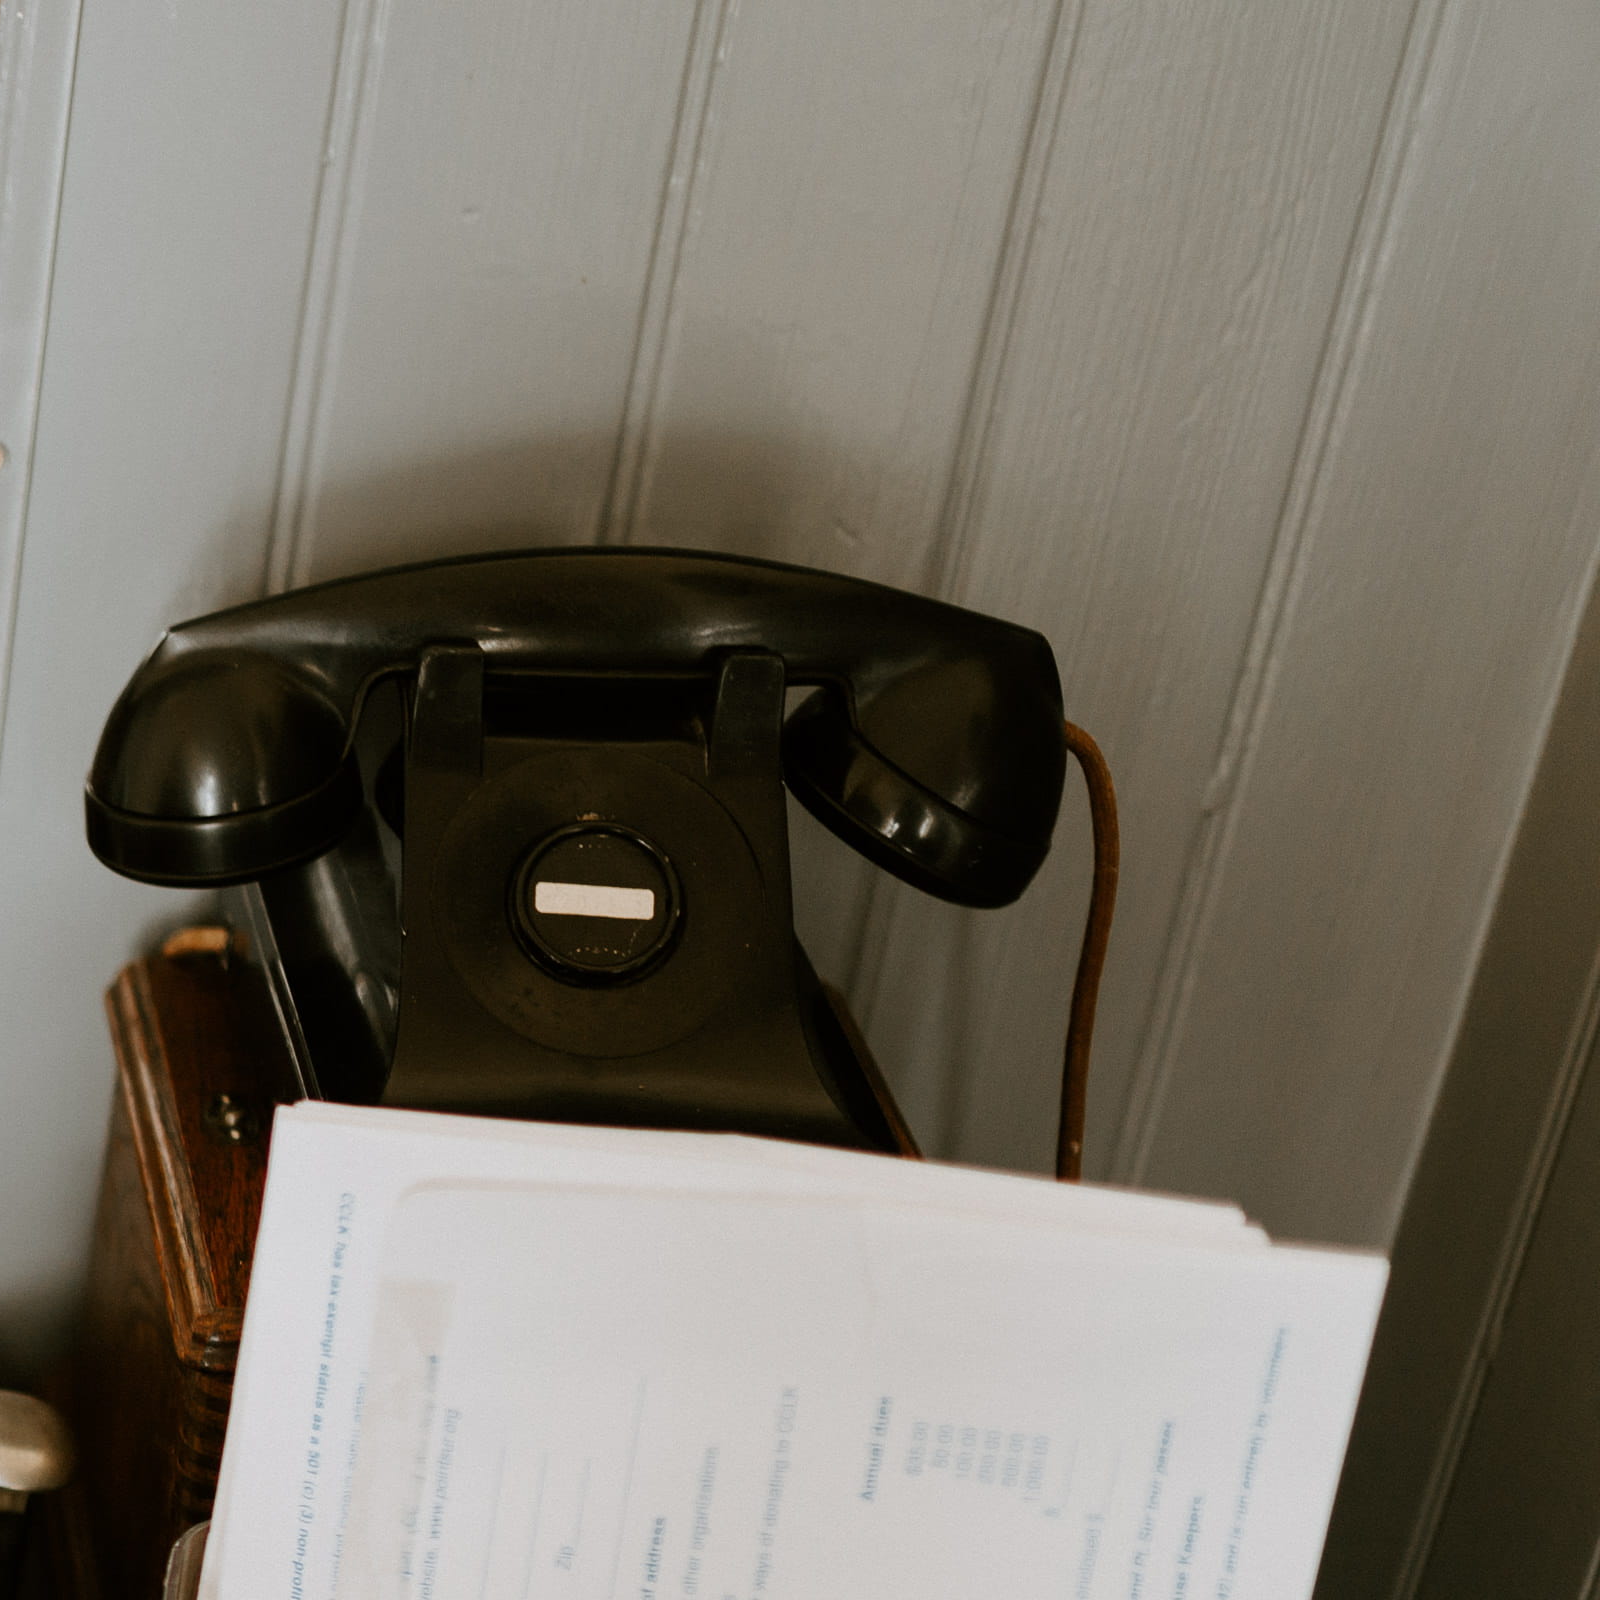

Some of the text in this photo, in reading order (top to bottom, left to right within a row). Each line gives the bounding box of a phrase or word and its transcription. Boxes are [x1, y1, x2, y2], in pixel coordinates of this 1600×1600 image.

[312, 1362, 332, 1409] status
[310, 1413, 326, 1432] as
[304, 1450, 321, 1476] 501
[856, 1393, 895, 1503] Annual dues
[299, 1479, 317, 1501] (c)
[761, 1456, 791, 1529] donating
[296, 1504, 315, 1524] (3)
[551, 1543, 576, 1570] Zip
[640, 1515, 667, 1584] address
[757, 1532, 775, 1547] of
[285, 1527, 311, 1600] non-profit
[681, 1554, 703, 1596] other
[752, 1551, 775, 1592] ways
